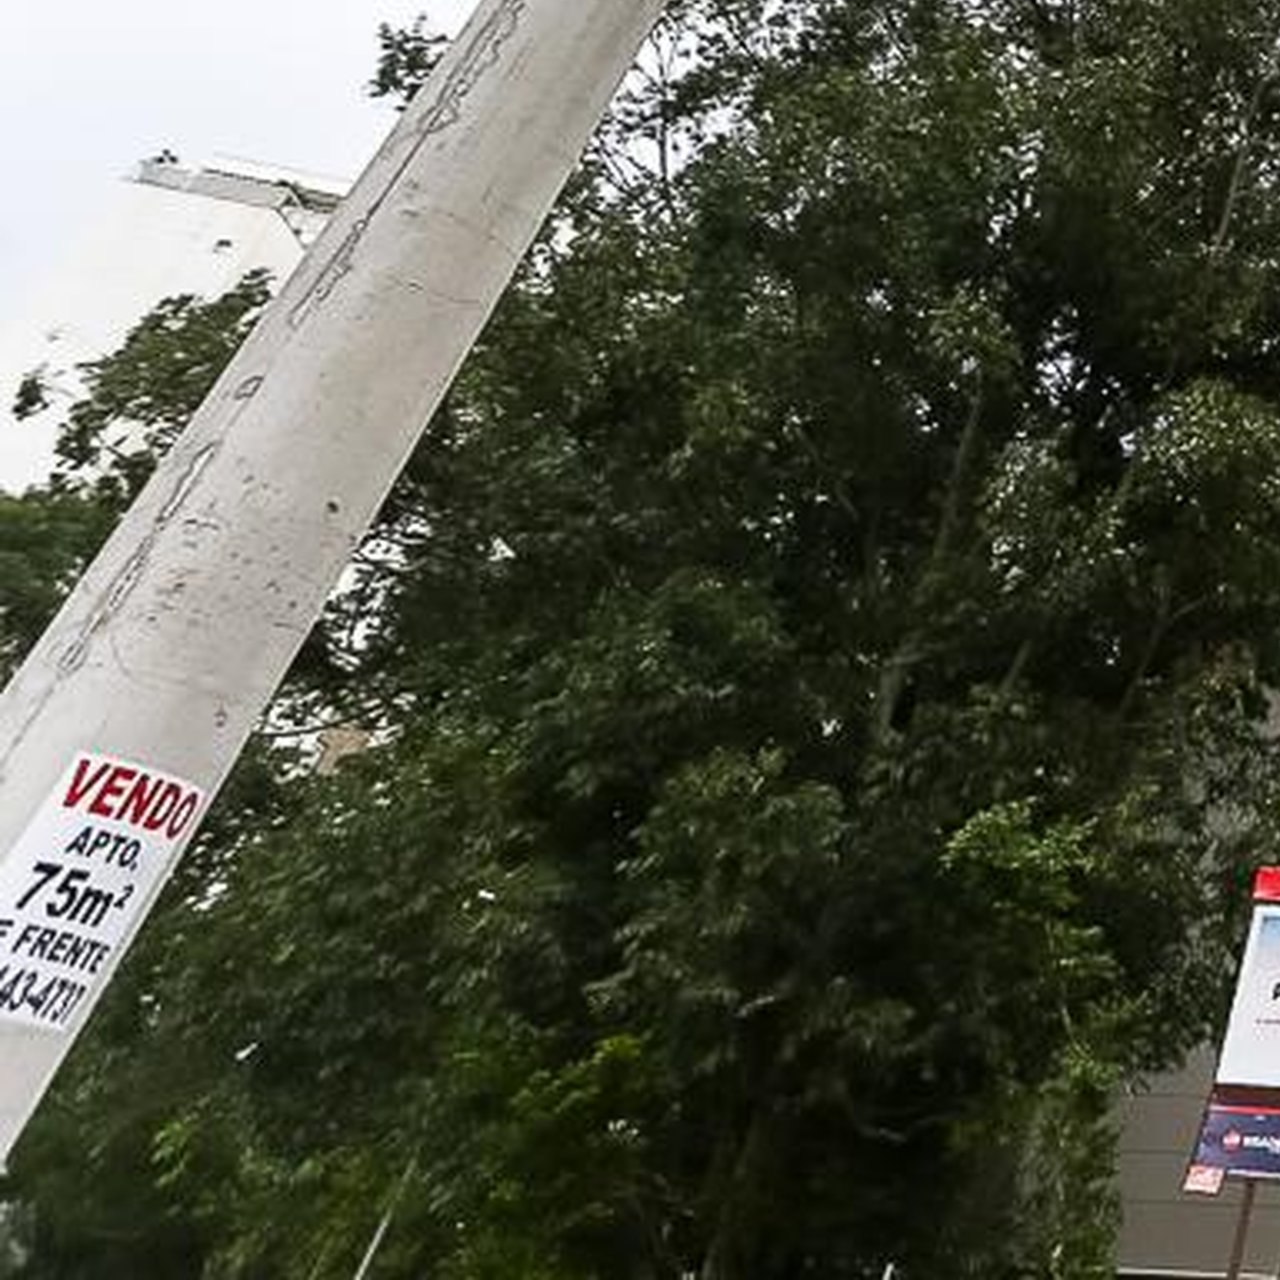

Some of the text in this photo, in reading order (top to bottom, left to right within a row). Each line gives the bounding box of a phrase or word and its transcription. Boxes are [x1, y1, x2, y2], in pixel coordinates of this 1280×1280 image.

[62, 759, 199, 840] VENDO
[65, 826, 141, 870] APTO.
[11, 923, 110, 973] FRENTE
